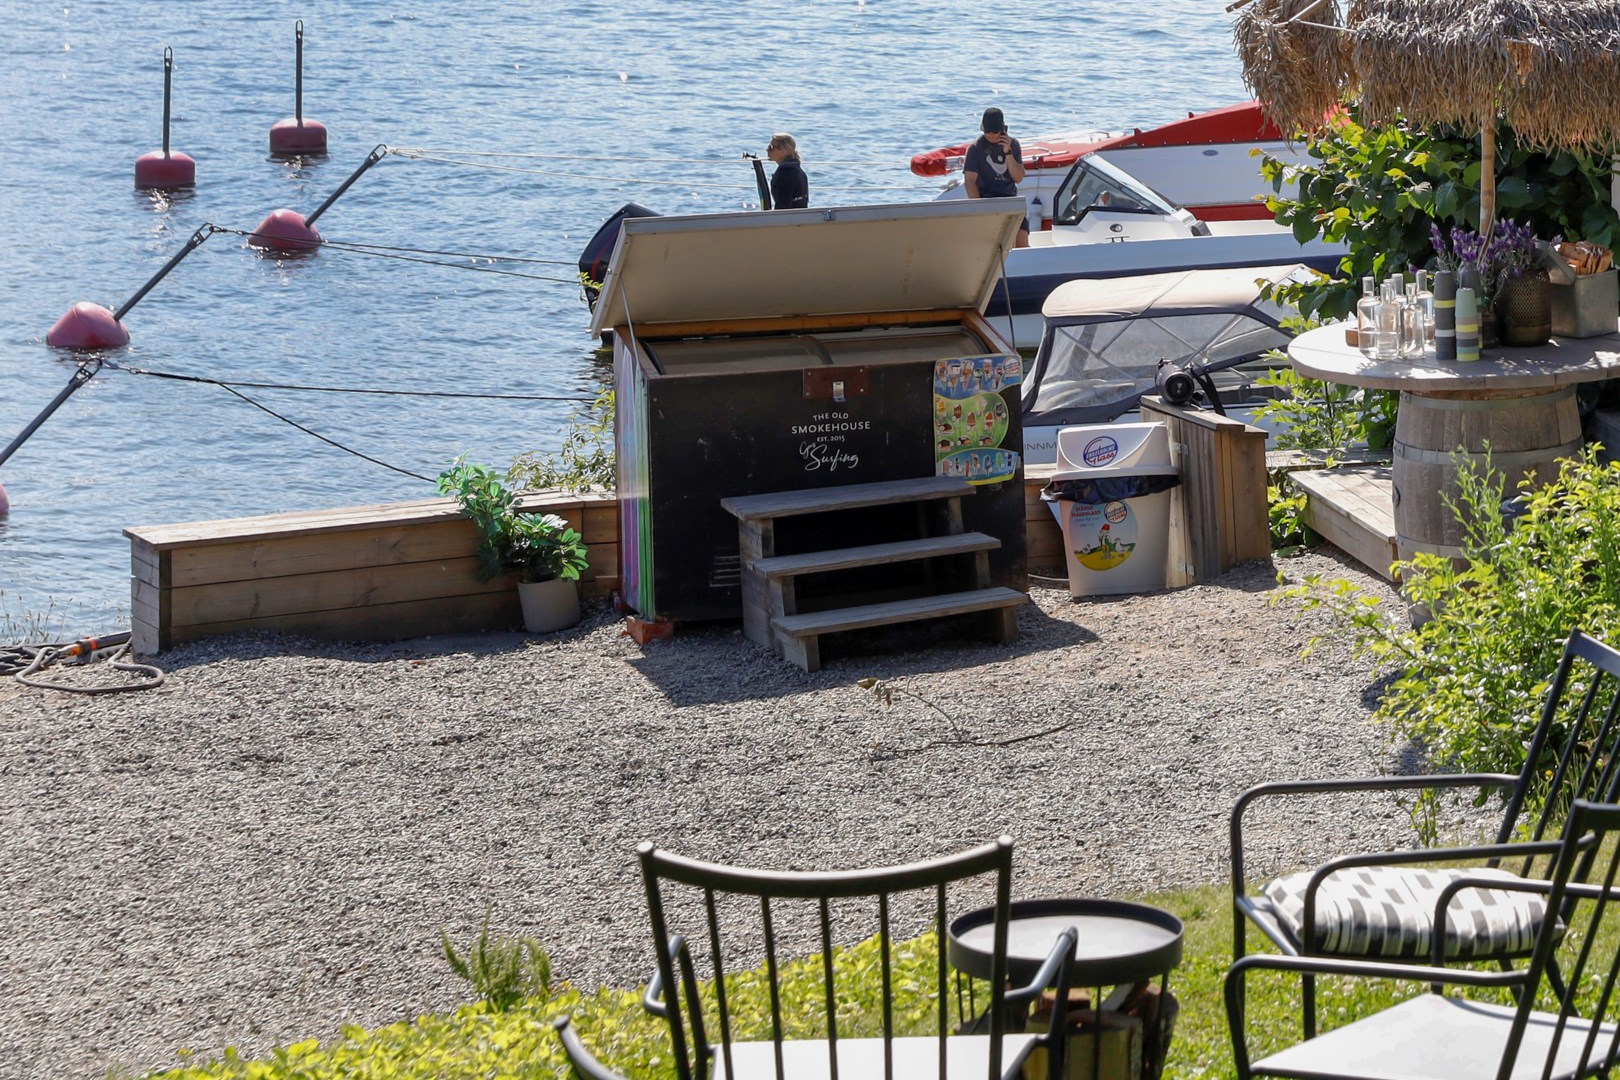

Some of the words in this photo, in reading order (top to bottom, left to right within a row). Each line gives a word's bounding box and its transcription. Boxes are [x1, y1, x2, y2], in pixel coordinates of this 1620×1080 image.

[812, 412, 830, 421] THE
[791, 421, 871, 434] SMOKEHOUSE
[830, 435, 846, 443] 2015
[804, 443, 859, 472] Surfing
